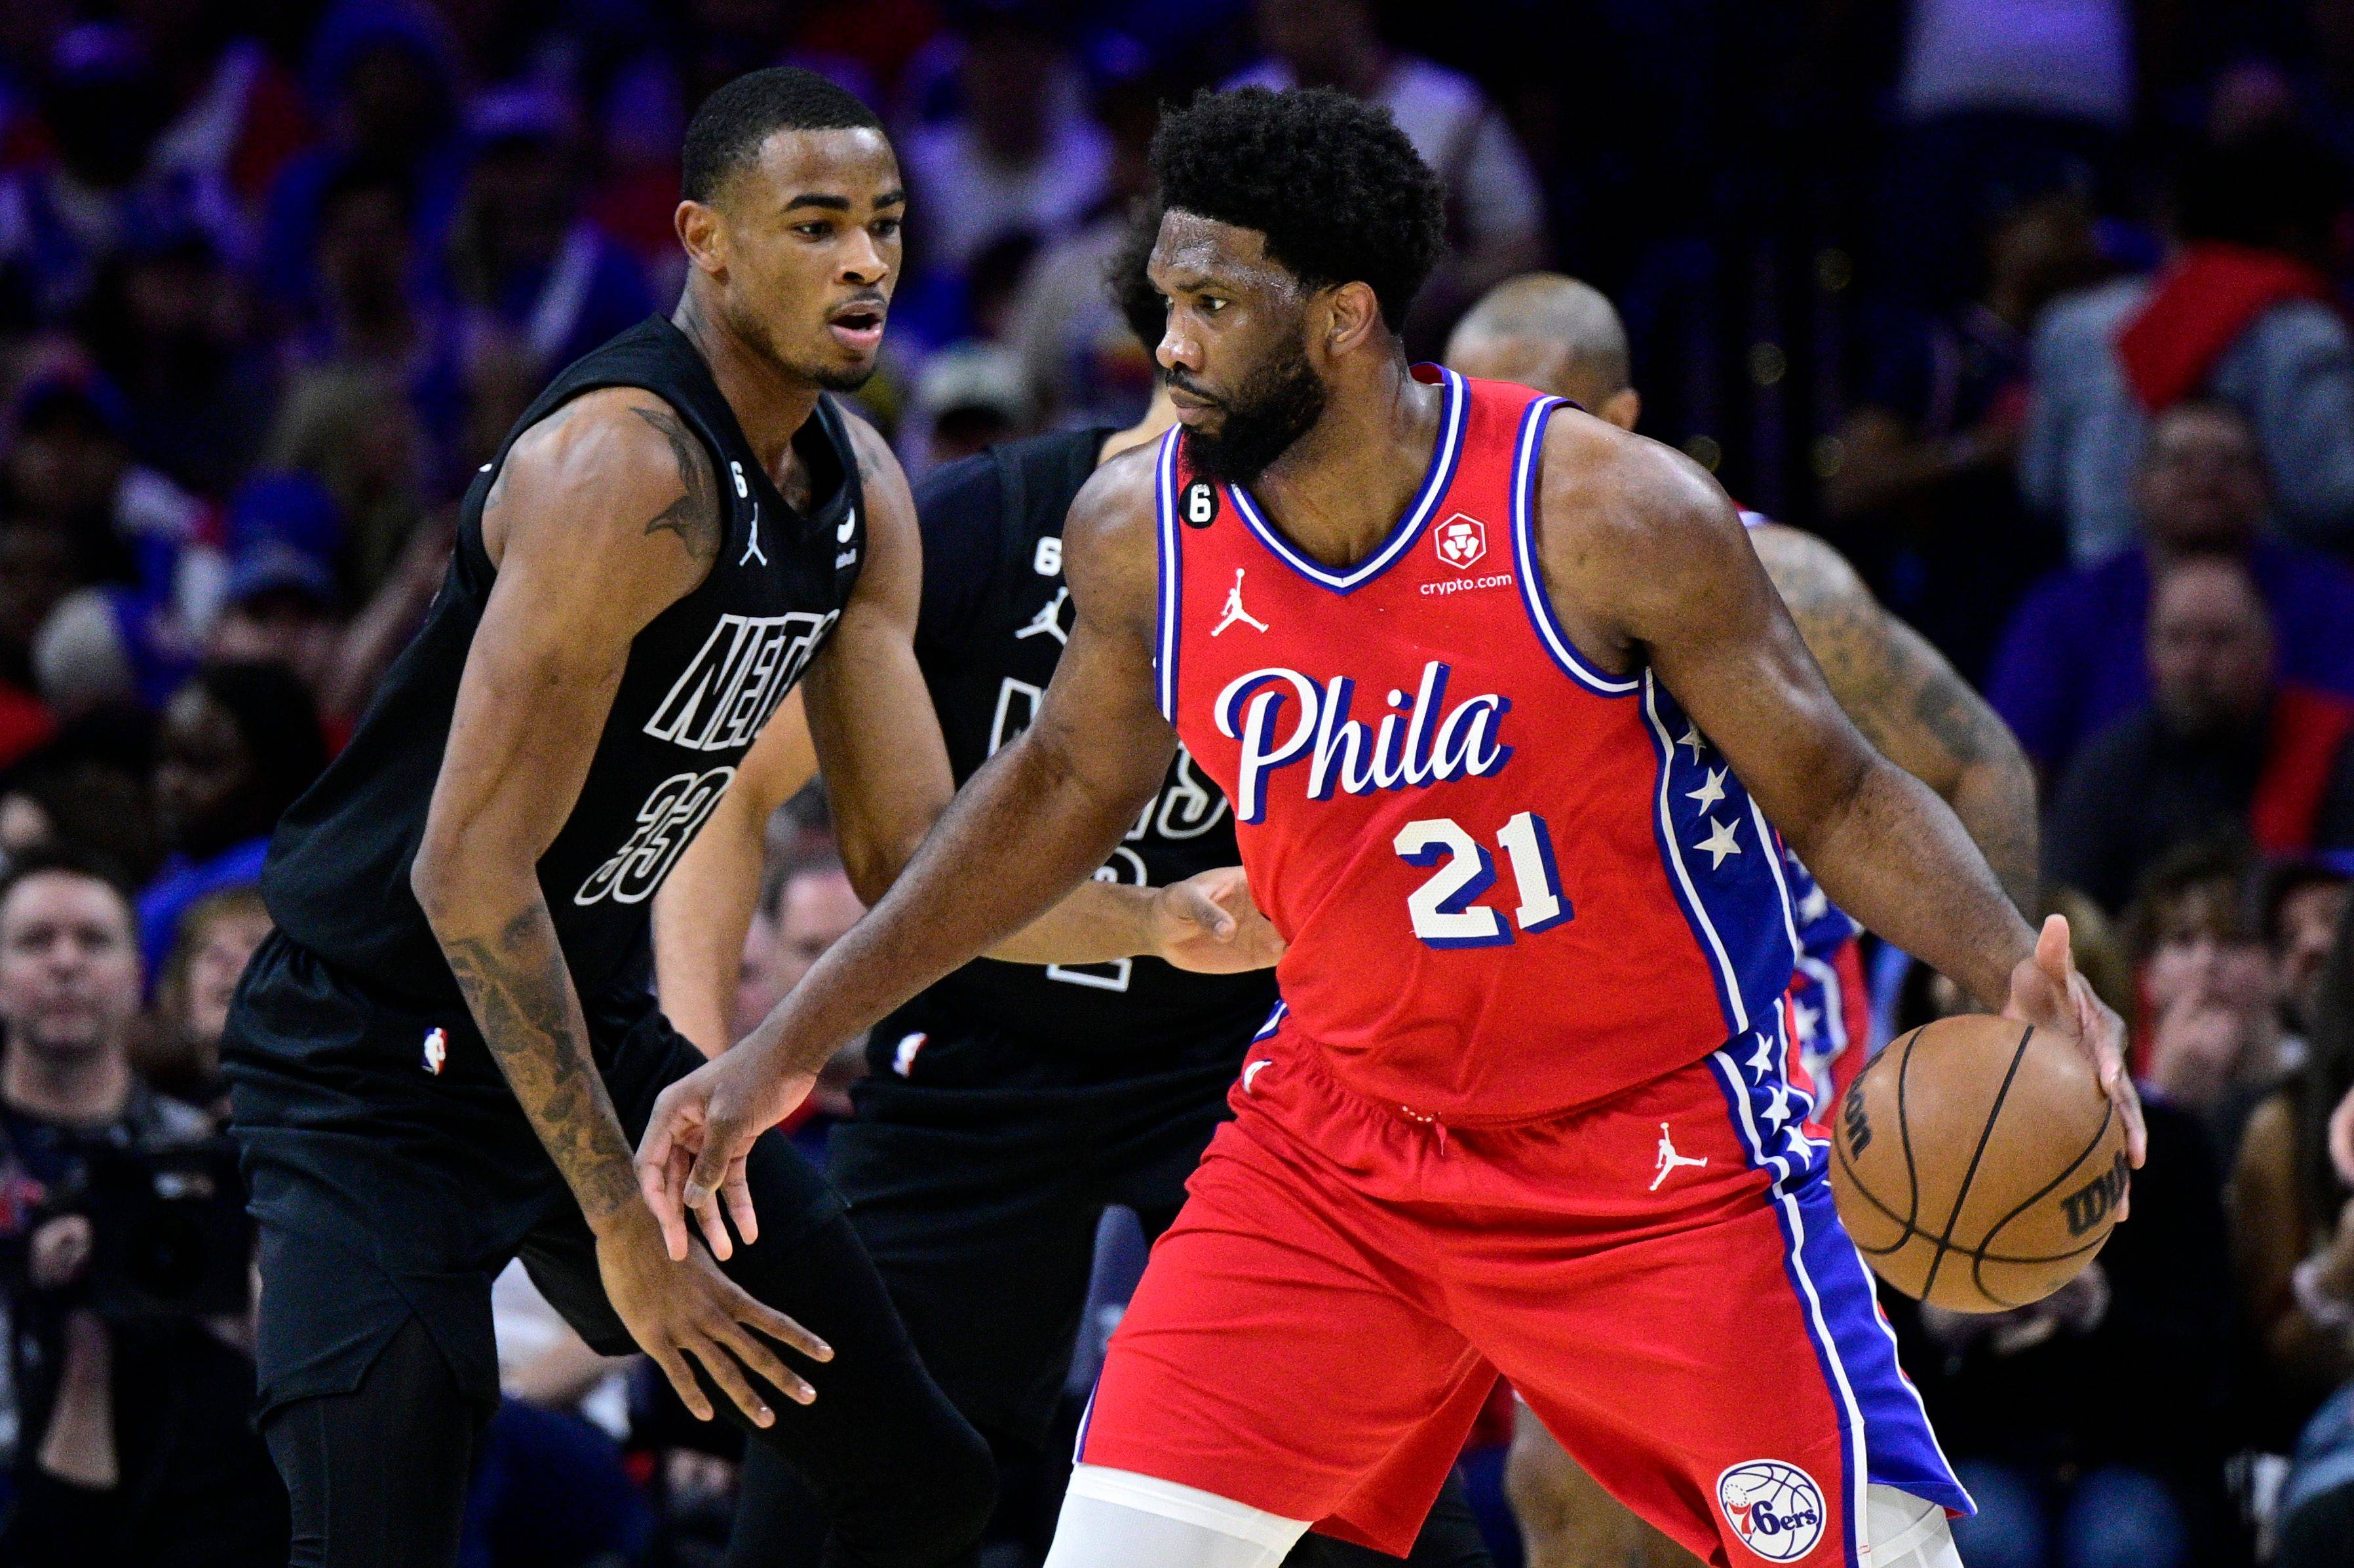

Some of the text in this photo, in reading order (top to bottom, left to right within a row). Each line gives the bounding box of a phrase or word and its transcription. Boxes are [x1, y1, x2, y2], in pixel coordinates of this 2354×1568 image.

[730, 461, 748, 498] 6
[1189, 484, 1211, 522] 6
[1033, 536, 1062, 576] 6
[1420, 574, 1512, 595] crypto.com
[1214, 660, 1514, 824] Phila
[574, 766, 737, 906] 33
[1393, 811, 1574, 949] 21
[1728, 1500, 1818, 1536] 76ers
